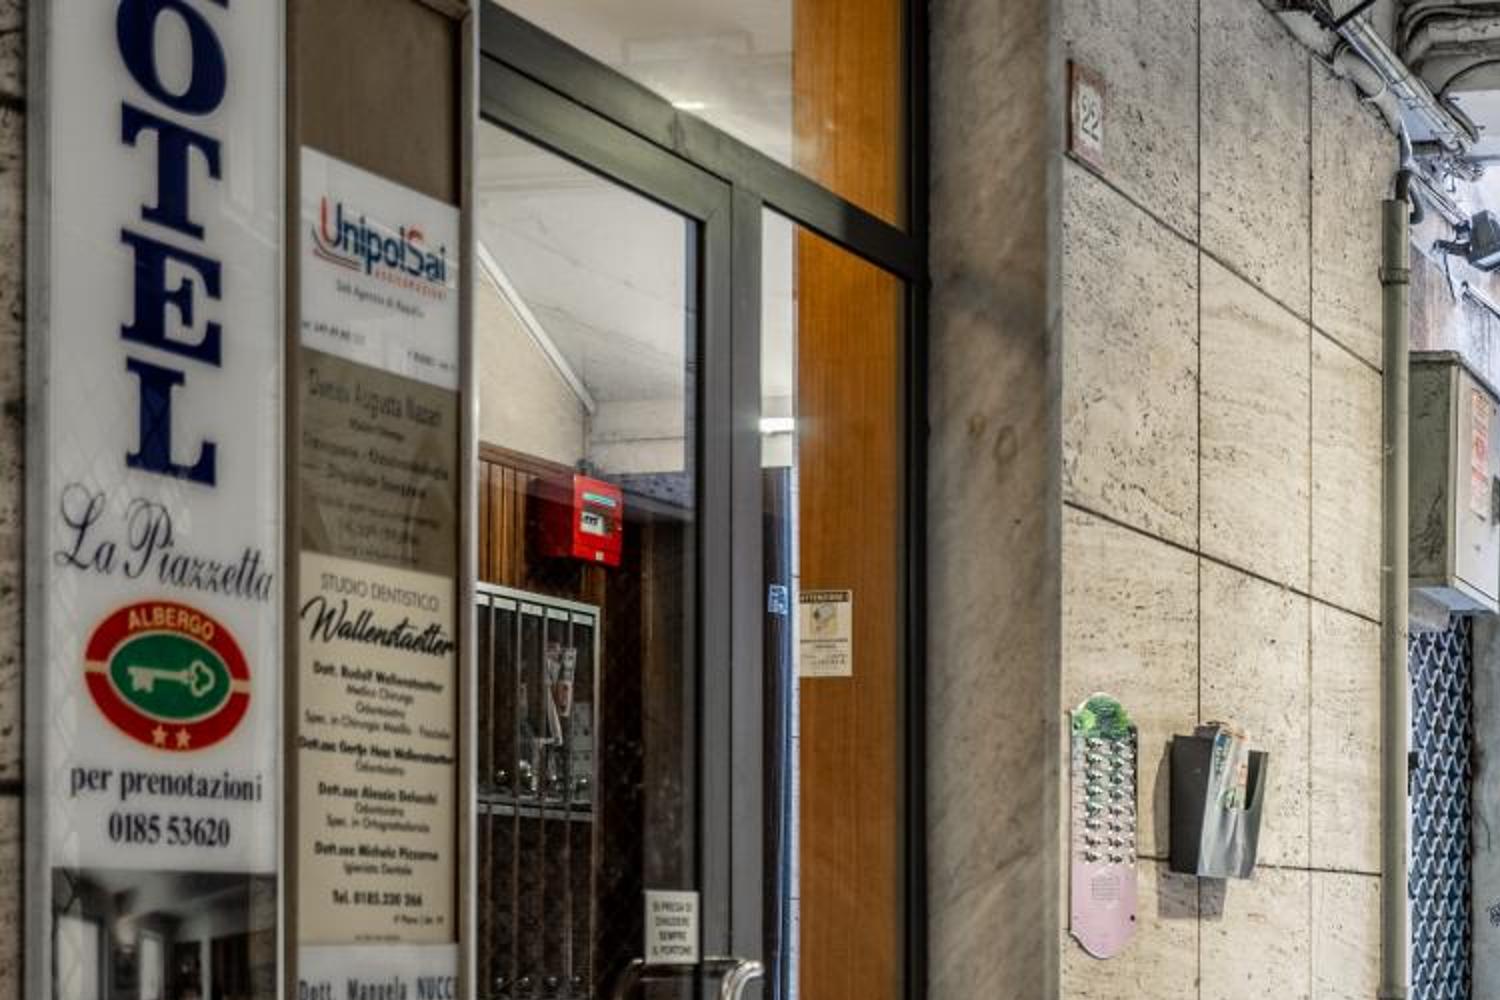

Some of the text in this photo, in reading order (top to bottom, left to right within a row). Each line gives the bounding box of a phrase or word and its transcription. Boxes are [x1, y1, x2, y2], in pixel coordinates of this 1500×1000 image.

[116, 0, 229, 487] OTEL
[320, 196, 446, 282] UnipolSai
[54, 482, 273, 601] La Piazzetta
[320, 572, 440, 612] STUDIO DENTISTICO
[128, 606, 215, 642] ALBERGO
[70, 767, 262, 801] per prenotazioni
[109, 812, 231, 848] 0185 53620
